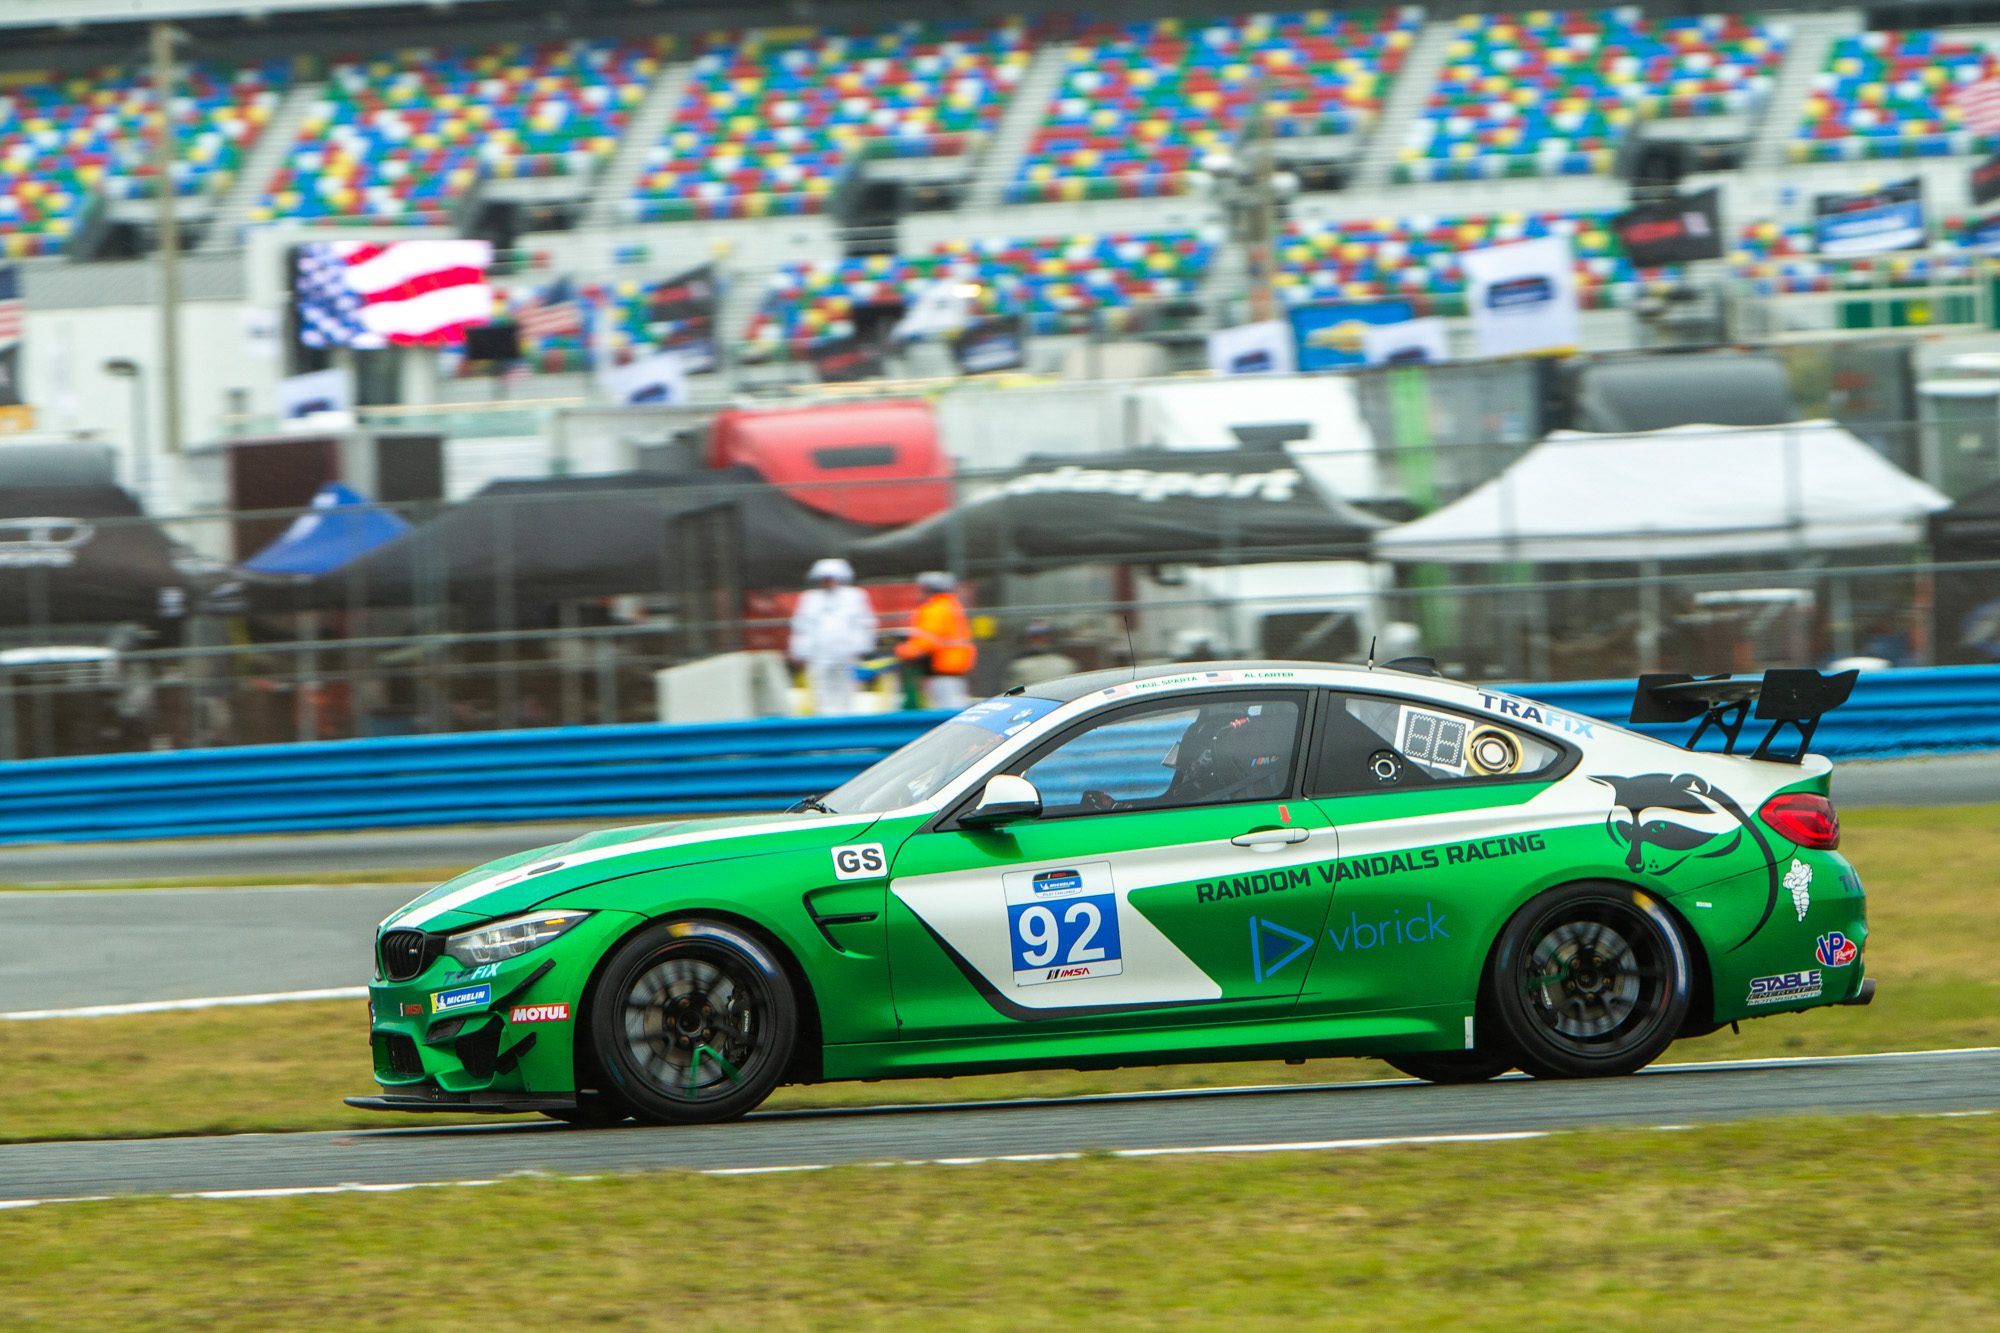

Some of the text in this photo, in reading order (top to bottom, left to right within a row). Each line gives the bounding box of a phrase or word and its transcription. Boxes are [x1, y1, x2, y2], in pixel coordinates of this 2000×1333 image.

[1135, 682, 1160, 690] PAUL
[837, 848, 883, 873] GS
[1196, 833, 1546, 904] RANDOM VANDALS RACING
[1018, 901, 1106, 967] 92
[1328, 900, 1451, 952] vbrick
[1816, 931, 1845, 967] VP
[1060, 967, 1090, 978] IMSA
[1751, 969, 1821, 993] STABLE
[446, 991, 485, 1004] MICHELIN
[512, 1006, 567, 1022] MOTUL
